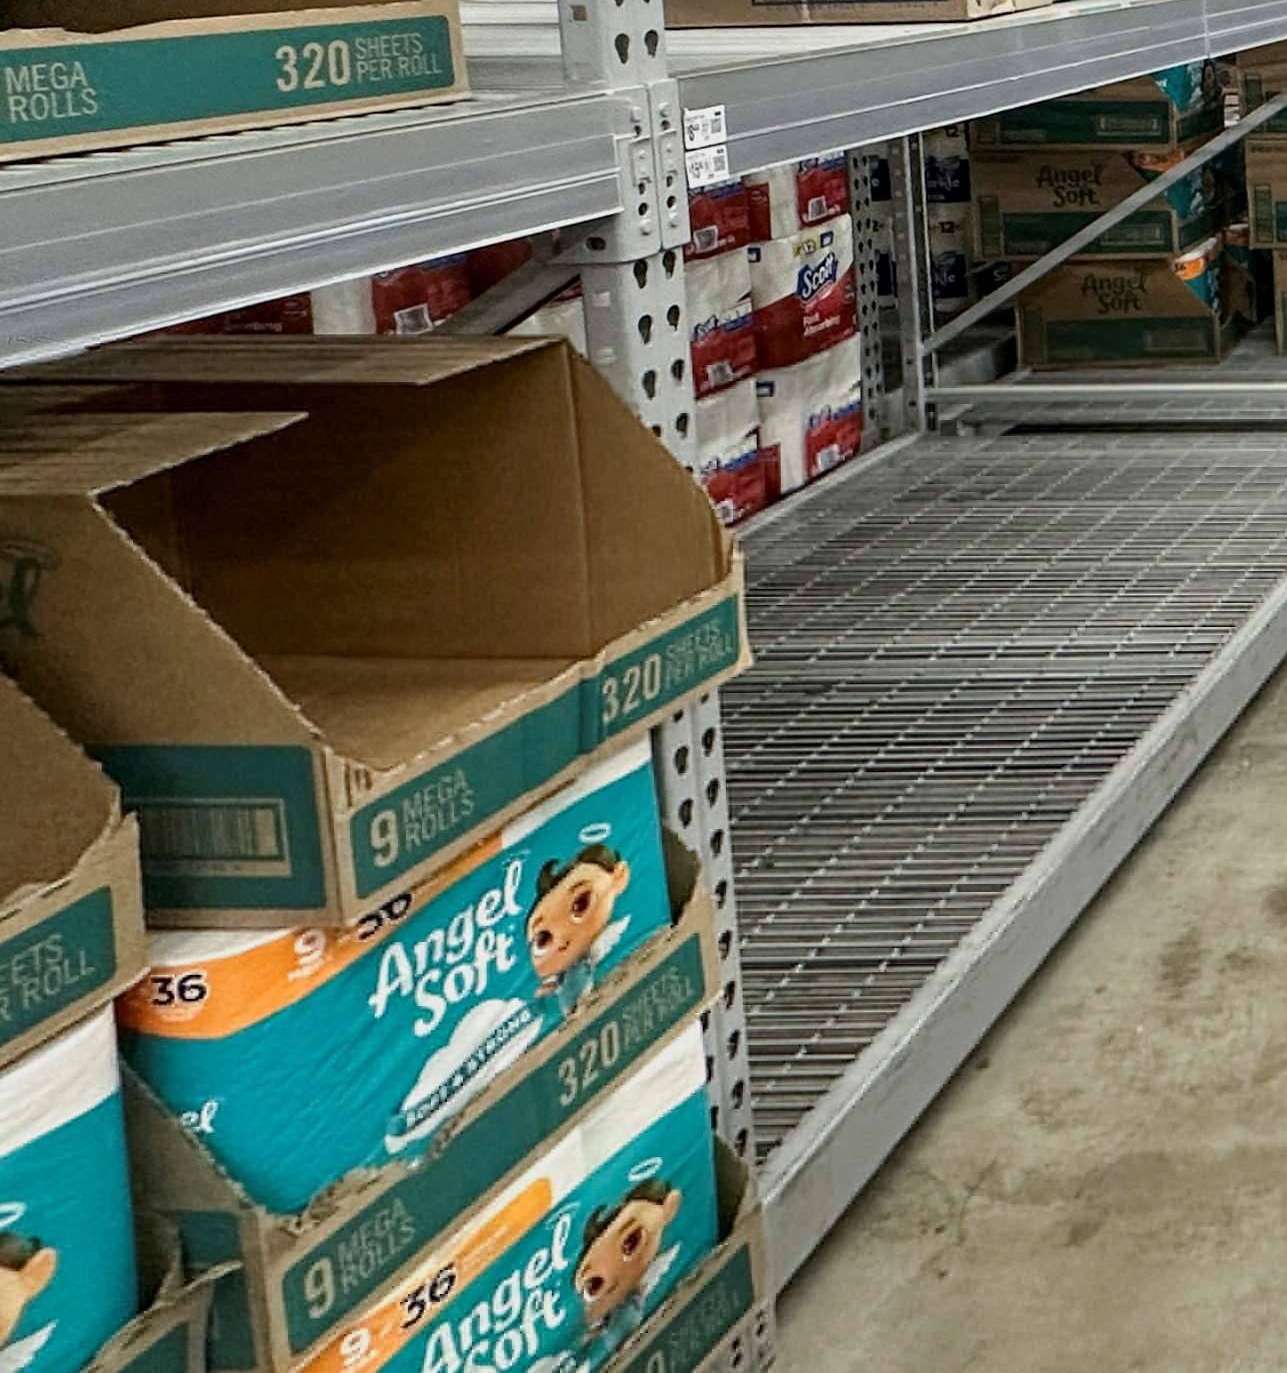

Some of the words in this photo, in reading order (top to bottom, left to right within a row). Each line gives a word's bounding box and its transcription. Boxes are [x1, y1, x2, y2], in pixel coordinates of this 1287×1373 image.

[4, 61, 88, 93] MEGA
[274, 39, 351, 92] 320
[354, 32, 424, 61] SHEETS
[356, 58, 392, 84] PER
[397, 53, 444, 78] ROLL
[8, 88, 98, 123] ROLLS
[1038, 165, 1102, 191] Angel
[1053, 187, 1100, 208] Soft
[802, 252, 836, 299] Scott
[1081, 272, 1146, 299] Angel
[1098, 293, 1142, 314] Soft
[602, 653, 662, 724] 320
[371, 809, 399, 867] 9
[402, 769, 468, 823] MEGA
[405, 788, 475, 852] ROLLS
[368, 859, 522, 1019] Angel
[22, 949, 96, 1010] ROLL
[150, 973, 208, 1007] 36
[414, 929, 516, 1038] Soft
[558, 1021, 619, 1106] 320
[305, 1257, 336, 1319] 9
[337, 1197, 408, 1263] MEGA
[340, 1216, 415, 1294] ROLLS
[420, 1212, 572, 1373] Angel
[339, 1328, 371, 1359] 9
